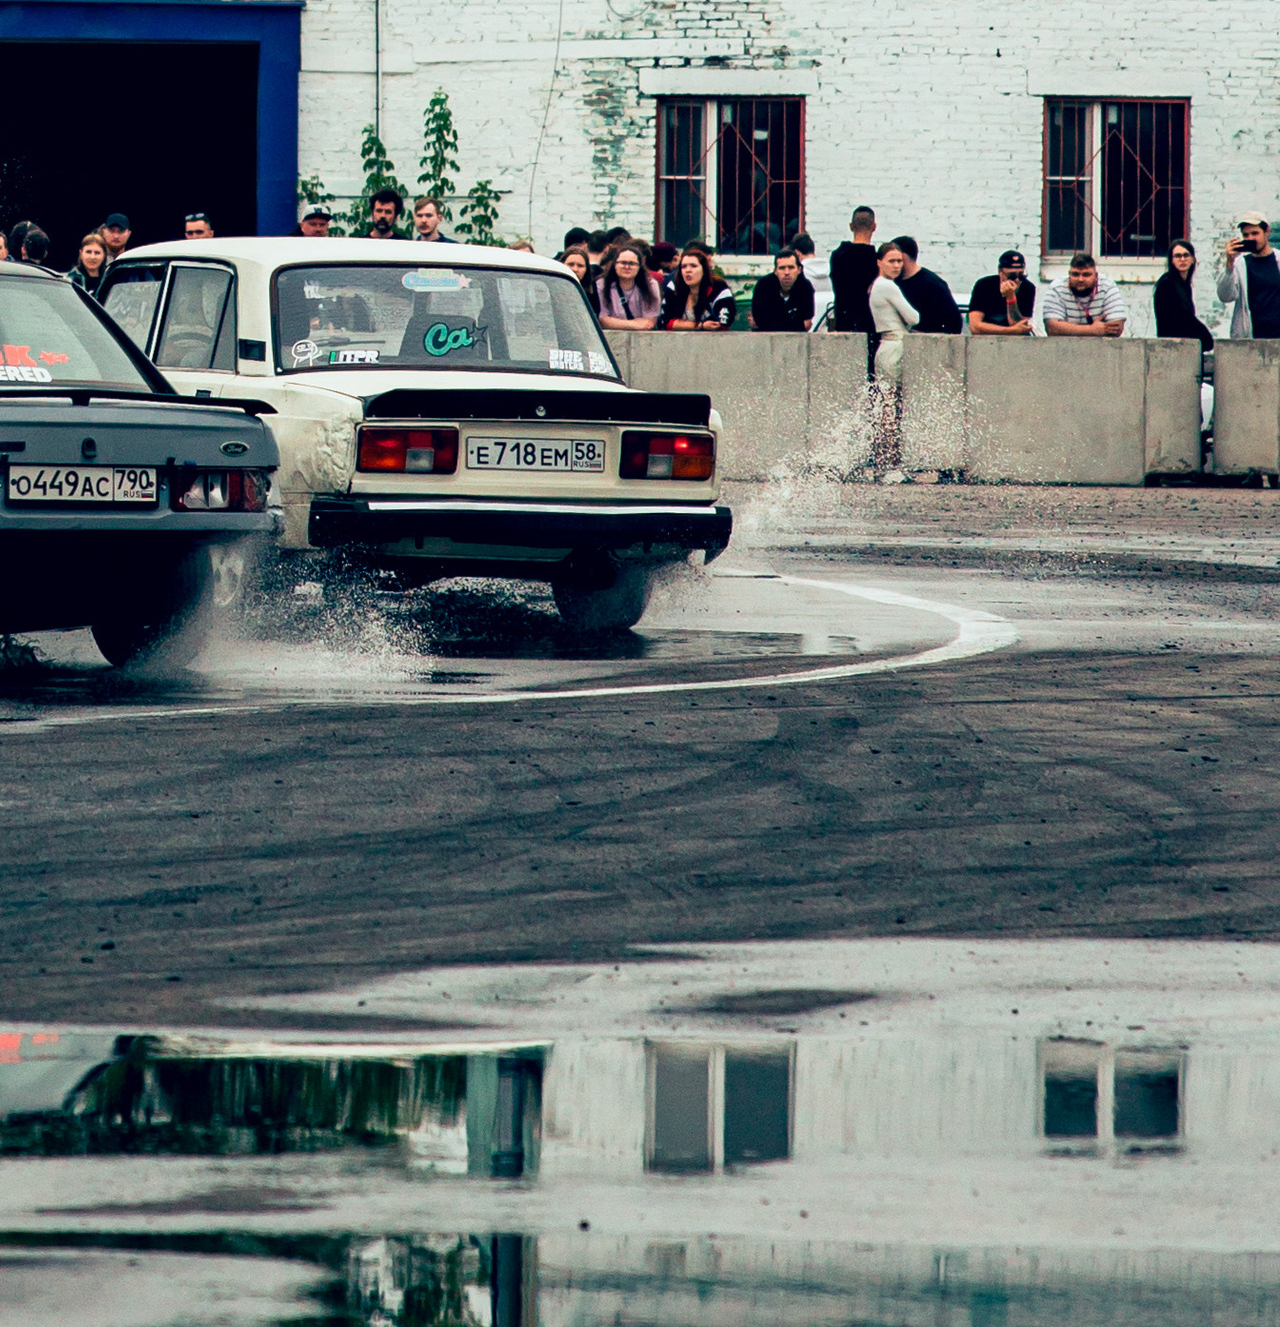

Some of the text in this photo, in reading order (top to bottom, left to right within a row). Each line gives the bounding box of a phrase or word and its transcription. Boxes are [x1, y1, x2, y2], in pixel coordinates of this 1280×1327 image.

[574, 442, 596, 461] 58
[573, 460, 589, 468] RUS
[116, 469, 151, 490] 790
[123, 490, 141, 498] RUS
